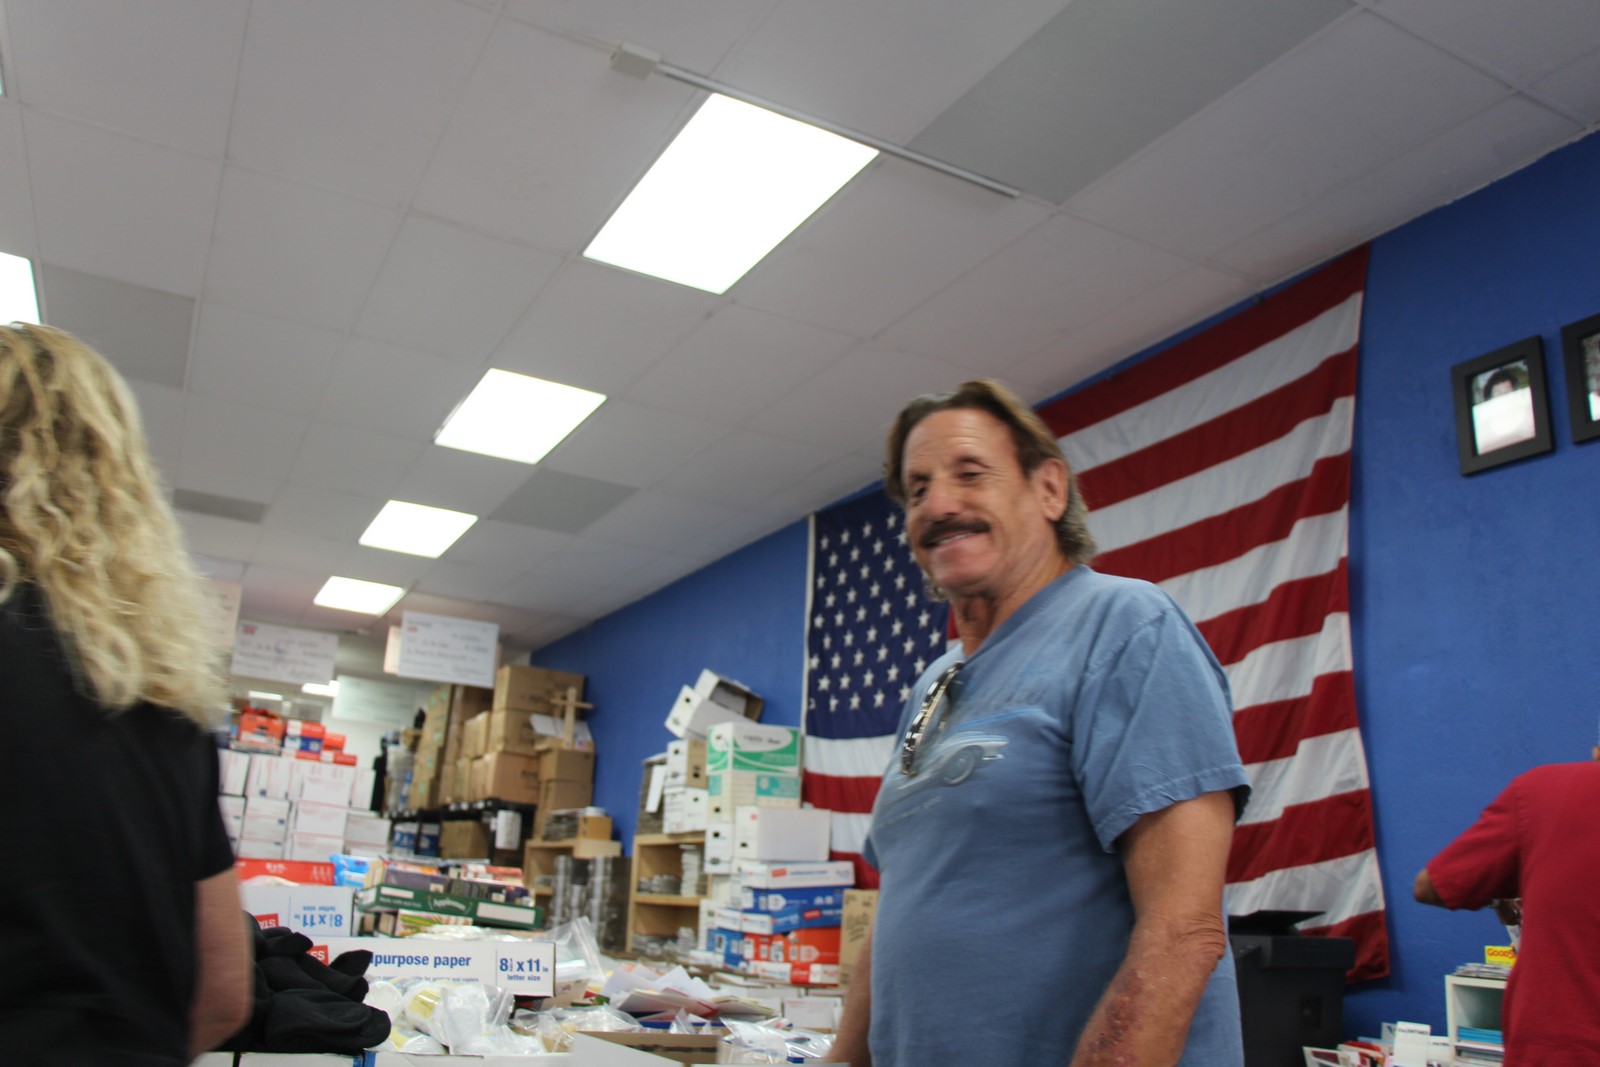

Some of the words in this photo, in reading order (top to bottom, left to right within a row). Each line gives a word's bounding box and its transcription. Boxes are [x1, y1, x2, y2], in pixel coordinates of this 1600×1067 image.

[302, 914, 316, 928] 11
[318, 914, 327, 925] x
[370, 953, 429, 968] purpose
[434, 955, 472, 969] paper
[516, 960, 525, 972] x
[526, 958, 540, 972] 11
